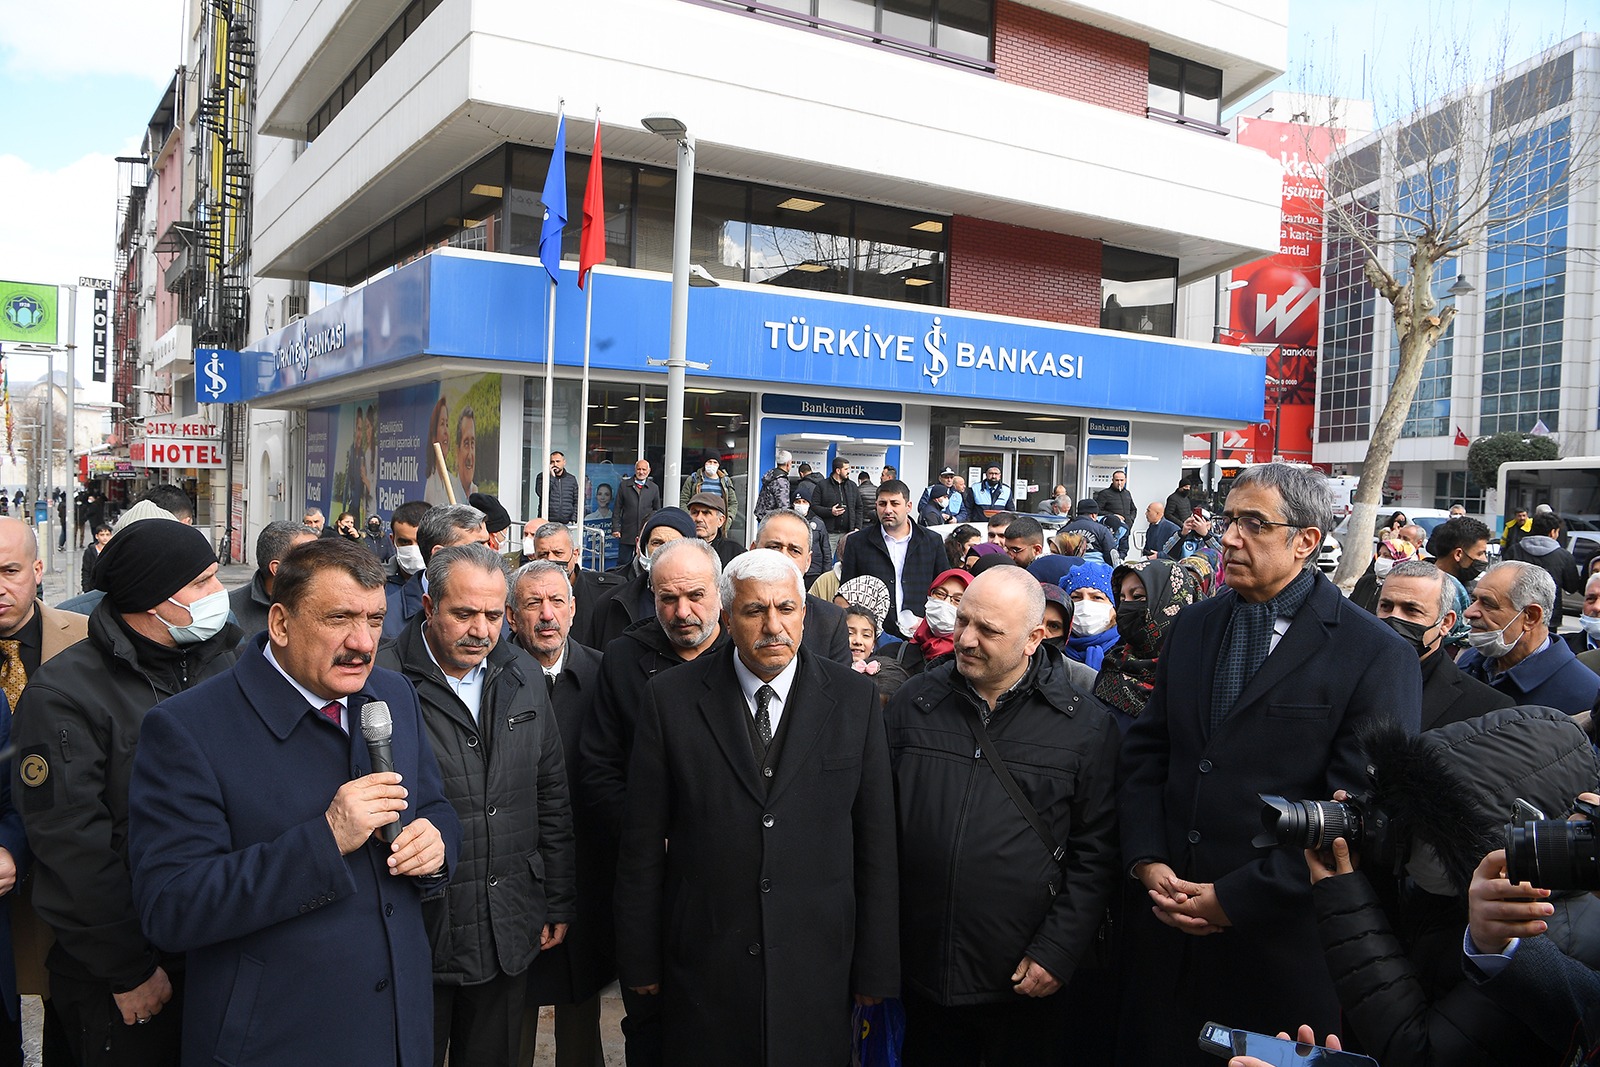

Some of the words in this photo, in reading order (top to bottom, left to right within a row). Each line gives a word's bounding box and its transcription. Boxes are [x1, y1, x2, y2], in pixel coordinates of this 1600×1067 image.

[1306, 215, 1319, 224] ve
[80, 277, 111, 290] PALACE
[94, 298, 106, 373] HOTEL
[308, 323, 345, 359] BANKASI
[764, 315, 915, 363] TÜRKİYE
[955, 341, 1083, 380] BANKASI
[801, 401, 865, 416] Bankamatik
[146, 422, 177, 435] CITY
[183, 423, 217, 436] KENT
[1089, 422, 1127, 433] Bankamatik
[993, 434, 1017, 443] Malatya
[1017, 435, 1036, 444] Şubesi
[151, 444, 222, 464] HOTEL
[380, 456, 418, 482] Emeklilik
[379, 487, 405, 512] Paketi
